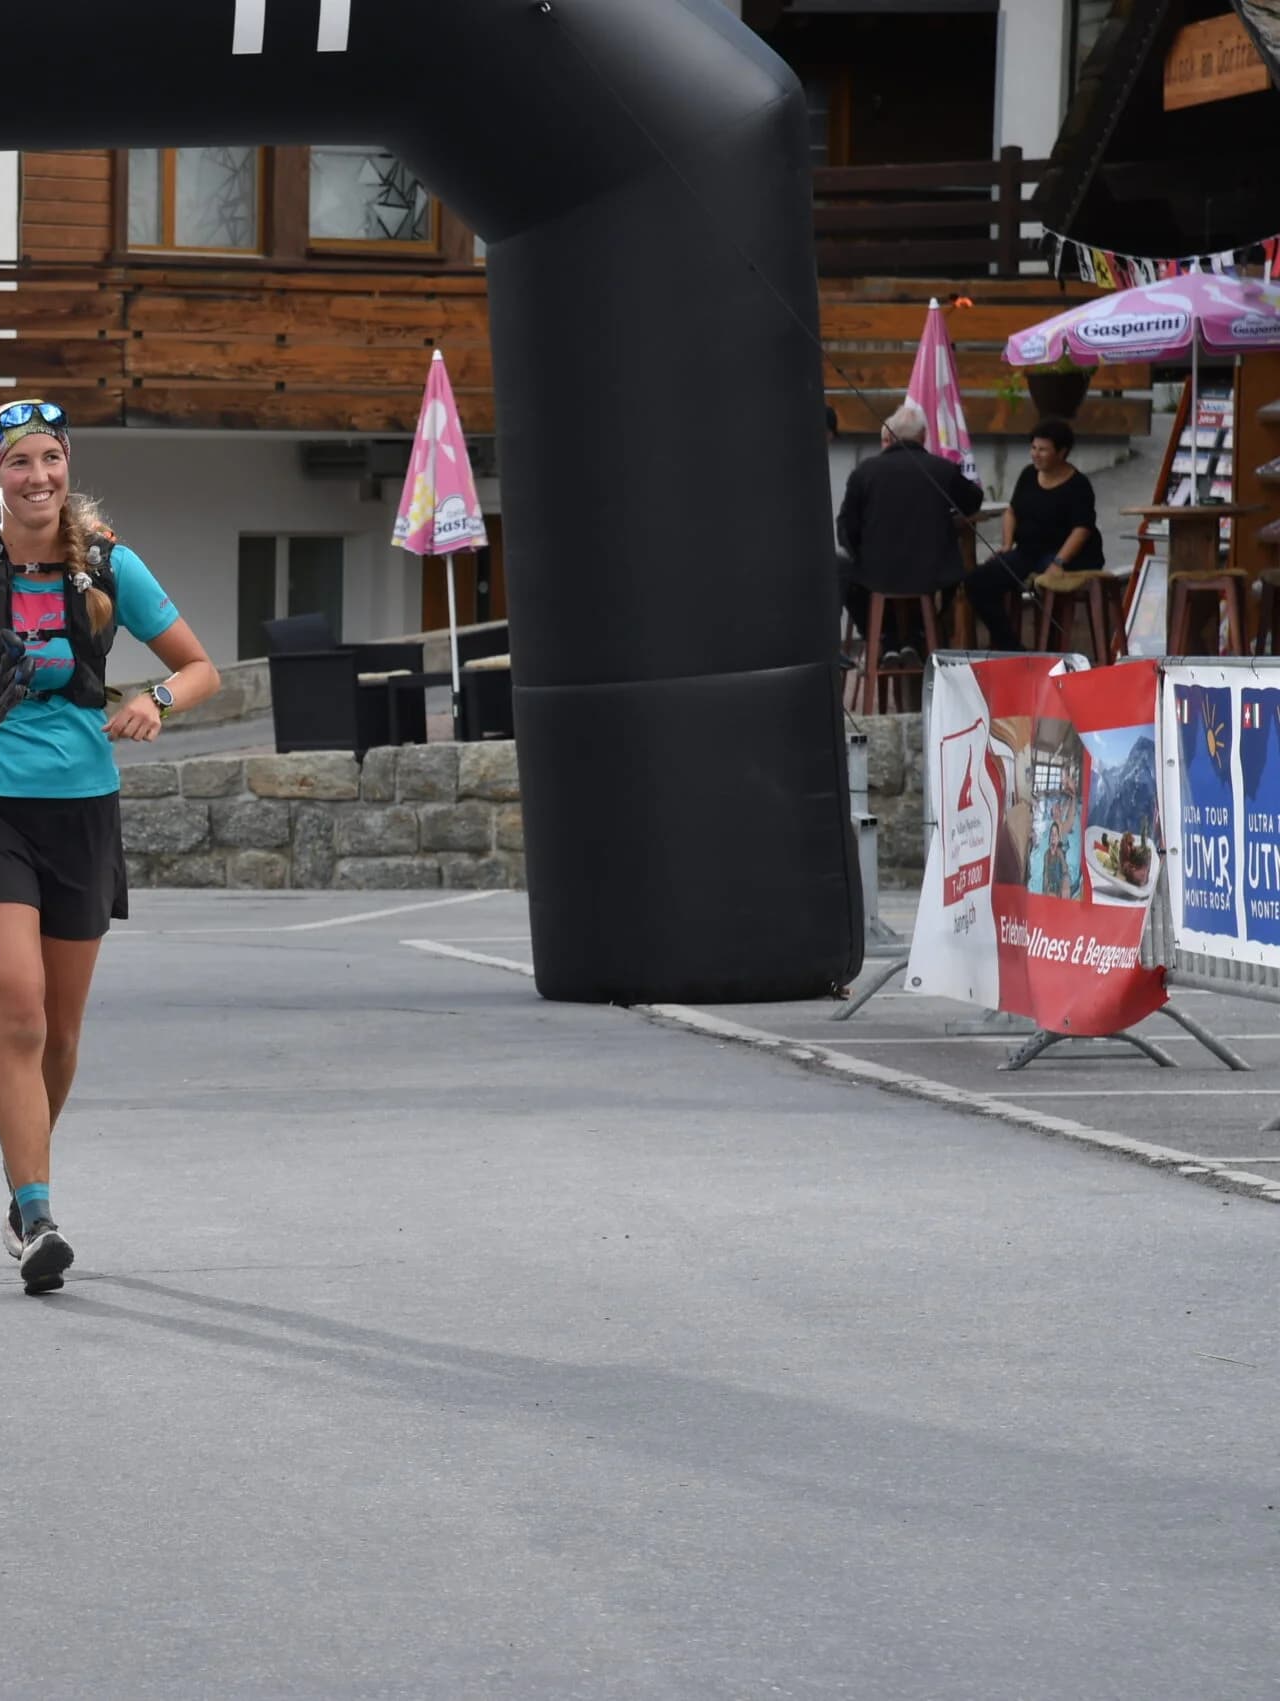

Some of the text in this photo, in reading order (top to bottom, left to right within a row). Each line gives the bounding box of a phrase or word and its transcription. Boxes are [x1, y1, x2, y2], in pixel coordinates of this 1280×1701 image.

[1083, 315, 1181, 338] Gasparini
[1205, 806, 1228, 826] TOUR
[1248, 813, 1274, 834] ULTRA
[1184, 832, 1232, 896] UTMR
[1184, 889, 1230, 911] MONTE ROSA
[1251, 899, 1280, 920] MONTE
[1071, 935, 1084, 964] &
